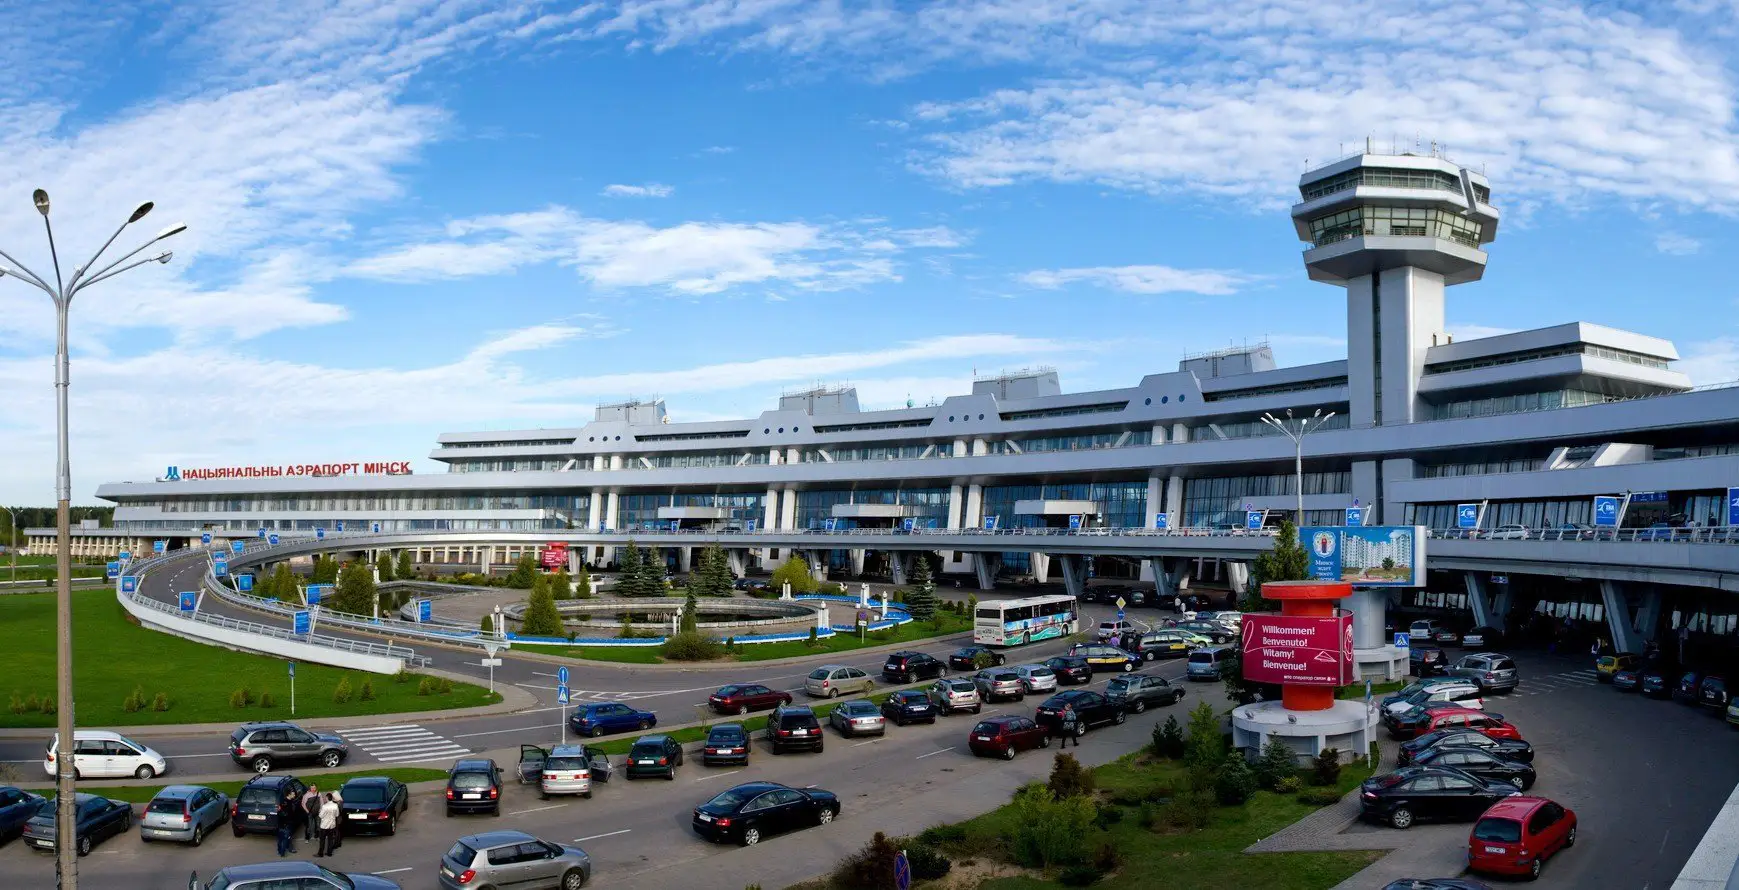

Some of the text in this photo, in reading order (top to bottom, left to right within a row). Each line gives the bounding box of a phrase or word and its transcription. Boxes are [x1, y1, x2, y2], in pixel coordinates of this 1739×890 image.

[182, 461, 411, 480] НАЦЫЯНАЛЬНЫ АЭРАПОРТ МІНСК
[1261, 625, 1315, 636] Willkommen!
[1262, 636, 1308, 647] Benvenuto!
[1262, 648, 1295, 660] Witamy!
[1263, 660, 1307, 671] Bienvenue!
